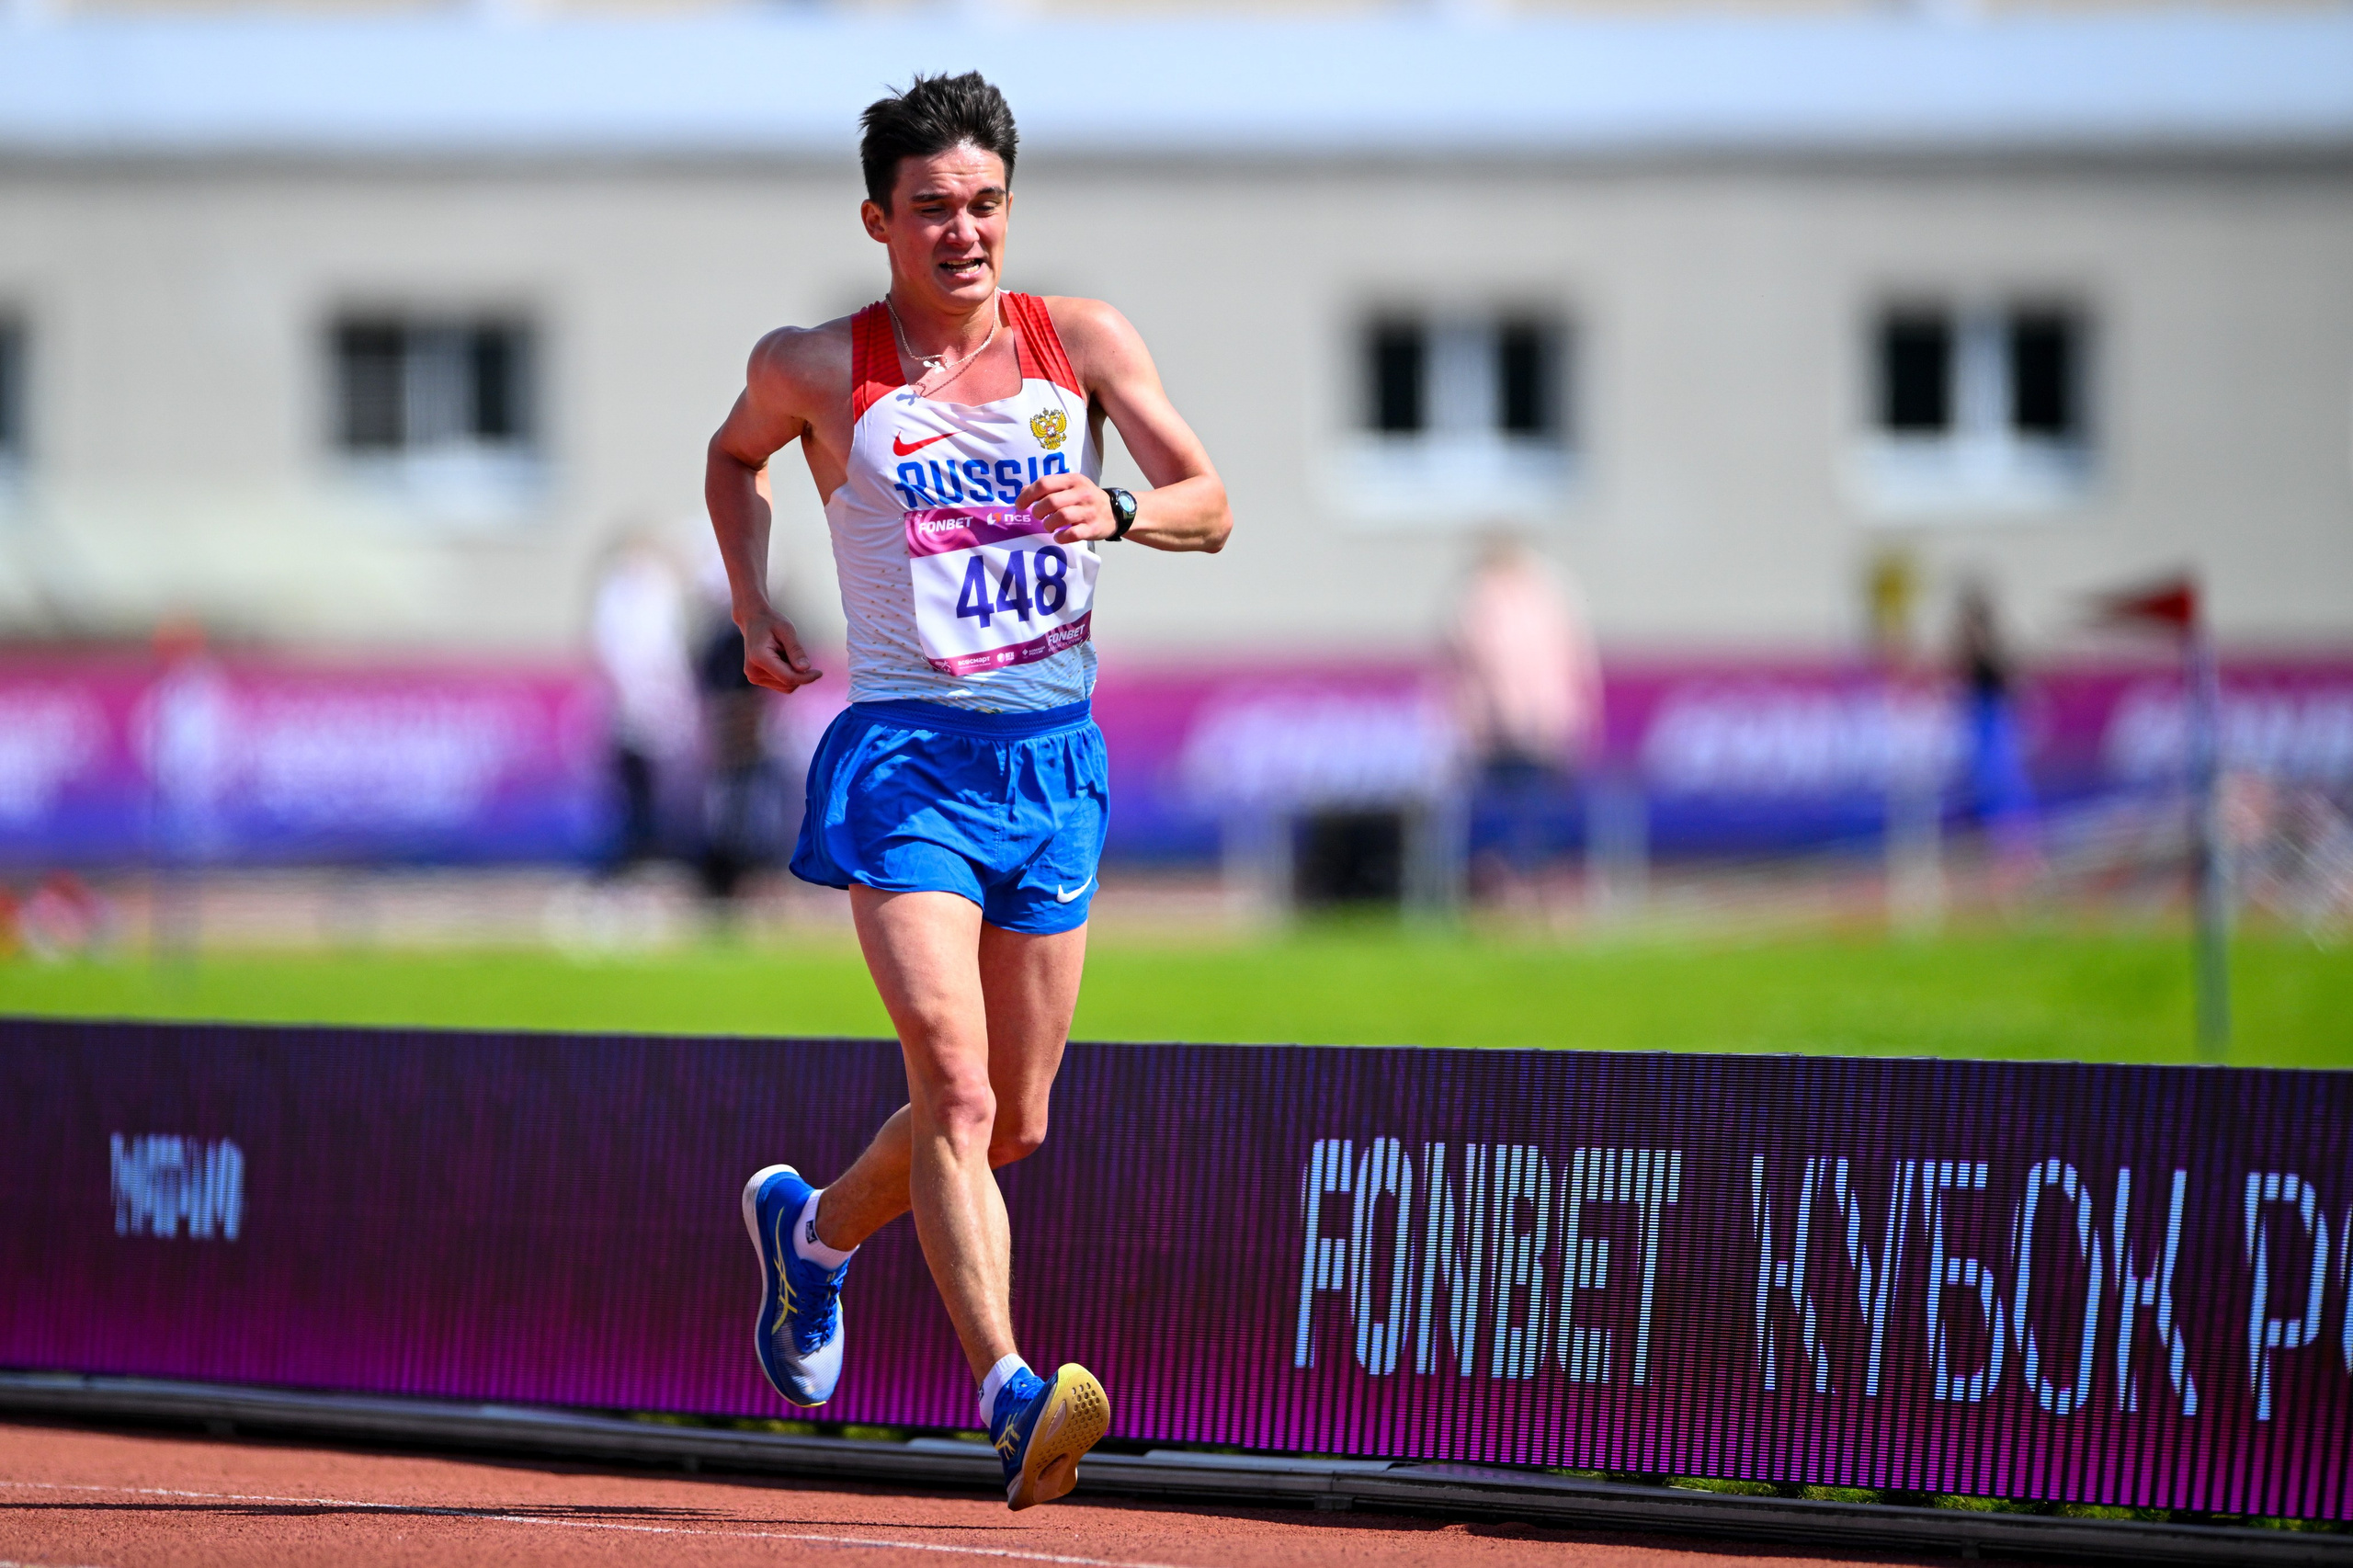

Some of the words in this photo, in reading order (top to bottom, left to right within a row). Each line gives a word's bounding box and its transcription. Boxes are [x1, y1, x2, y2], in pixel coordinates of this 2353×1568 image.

[918, 517, 973, 534] FONBET
[1004, 514, 1031, 522] ПСБ
[956, 545, 1067, 628] 448
[1048, 623, 1086, 646] FONBET
[1294, 1137, 1683, 1386] FONBET
[1751, 1155, 2198, 1416] КУБОК
